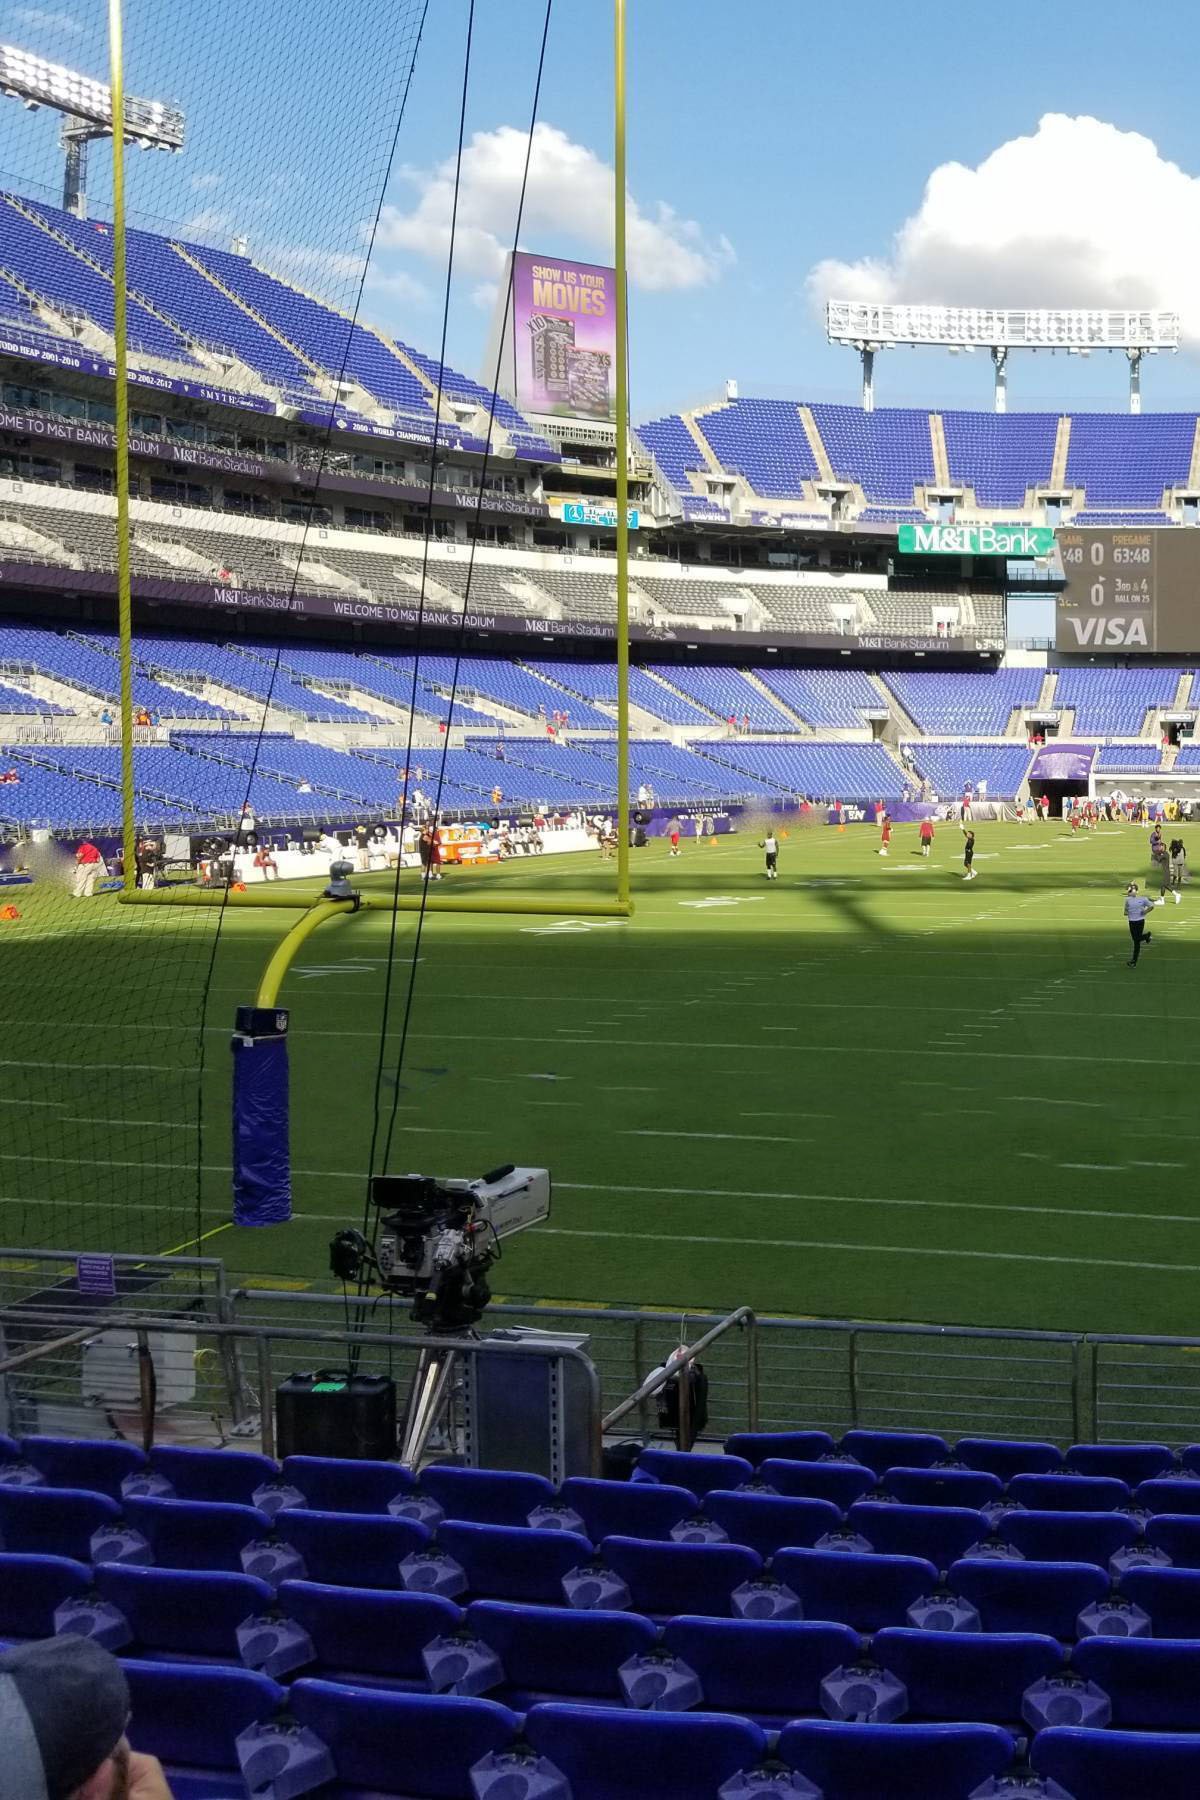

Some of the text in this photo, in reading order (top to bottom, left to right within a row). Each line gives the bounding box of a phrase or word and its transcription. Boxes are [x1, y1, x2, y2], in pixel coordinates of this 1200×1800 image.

[532, 265, 605, 289] SHOW US YOUR
[533, 279, 606, 317] MOVES
[20, 345, 40, 357] HEAP
[41, 352, 80, 367] 2001-2010
[138, 374, 173, 388] 2002-2012
[27, 420, 44, 433] TO
[48, 423, 74, 439] M&T
[77, 429, 108, 445] BANK
[111, 436, 159, 455] SADIUM
[372, 427, 395, 436] WORLD
[397, 431, 431, 443] CHAMPIONS
[173, 446, 262, 477] M&T Bank Stadium
[455, 494, 543, 516] M&T Bank Stadium
[913, 526, 1040, 553] M&T Bank
[1113, 535, 1152, 545] PREGAME
[1091, 542, 1104, 566] 0
[1113, 548, 1150, 563] 63:48
[1091, 584, 1104, 606] 0
[1141, 578, 1148, 593] 4
[214, 589, 304, 611] M&T Bank Stadium
[1114, 595, 1150, 604] BALL ON 25
[333, 602, 495, 628] WELCOME TO M&T BANK STADIUM
[525, 619, 614, 637] M&T Bank Stadium
[1065, 617, 1148, 646] VISA
[858, 637, 949, 649] M&T Bank Stadium
